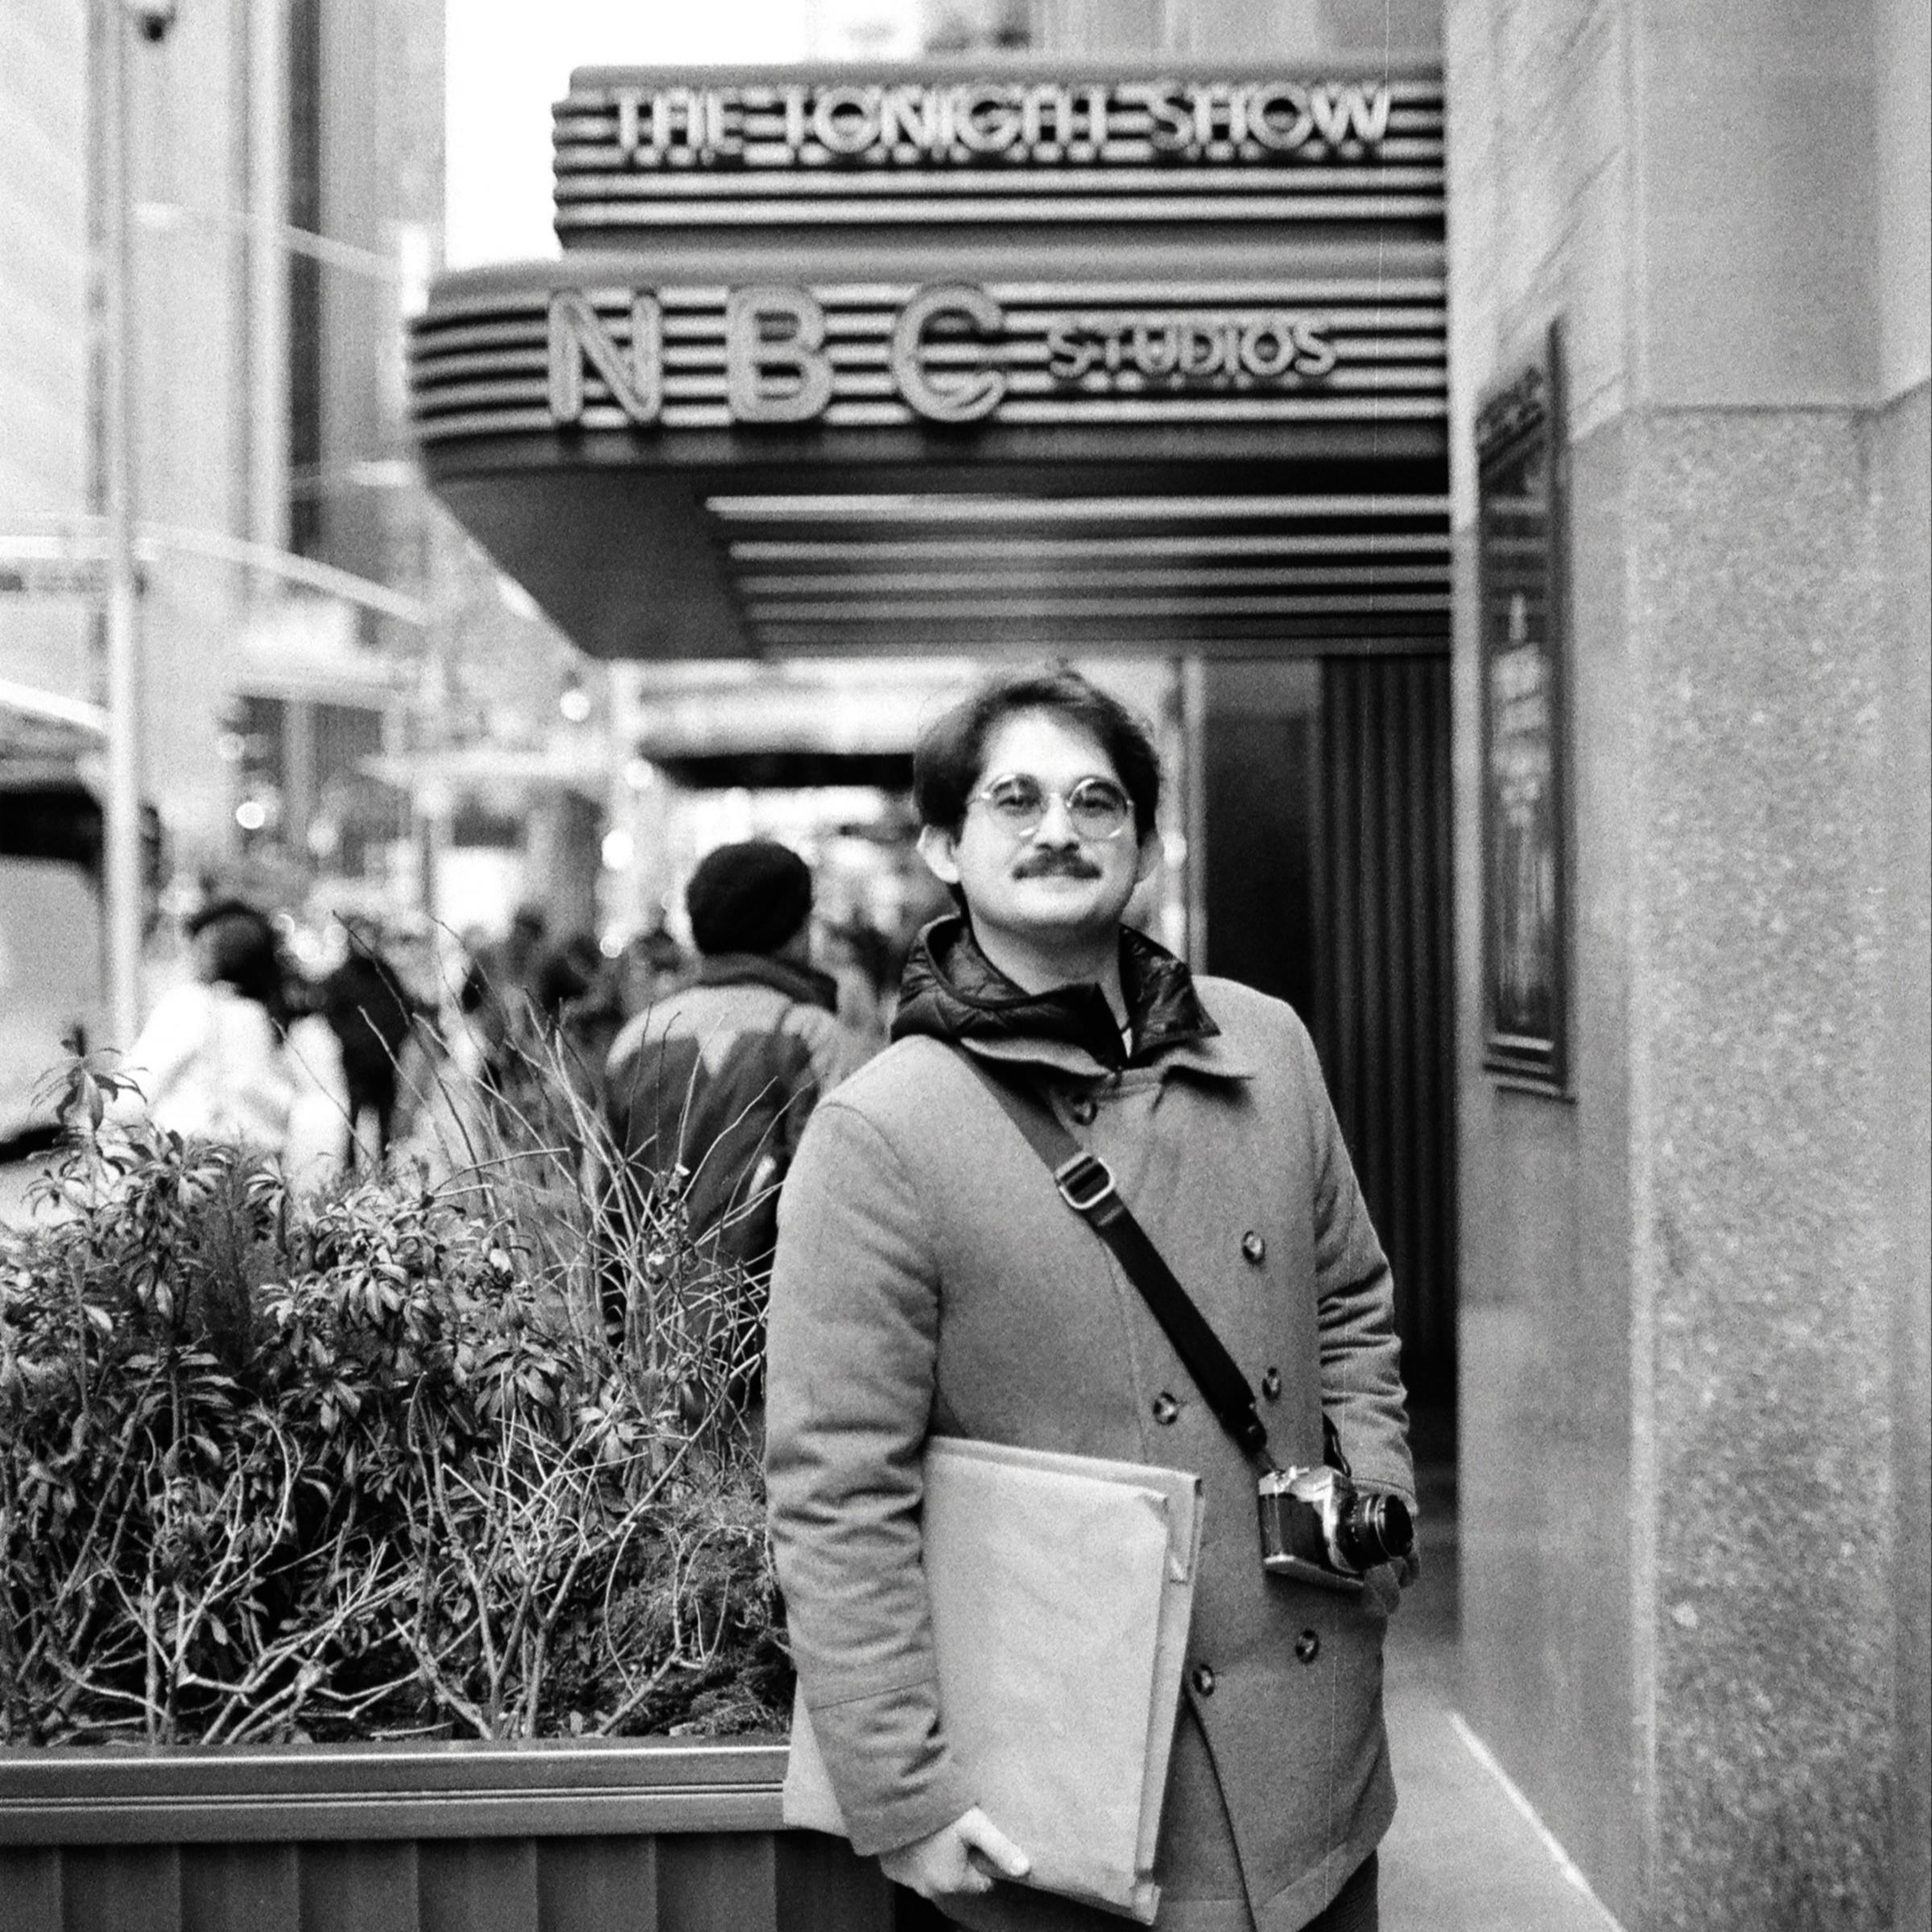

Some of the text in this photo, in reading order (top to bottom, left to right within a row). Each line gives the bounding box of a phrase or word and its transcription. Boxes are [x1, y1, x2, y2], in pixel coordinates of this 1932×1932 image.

[607, 81, 1390, 153] THE TONIGHT SHOW
[547, 285, 1337, 422] NBC STUDIOS
